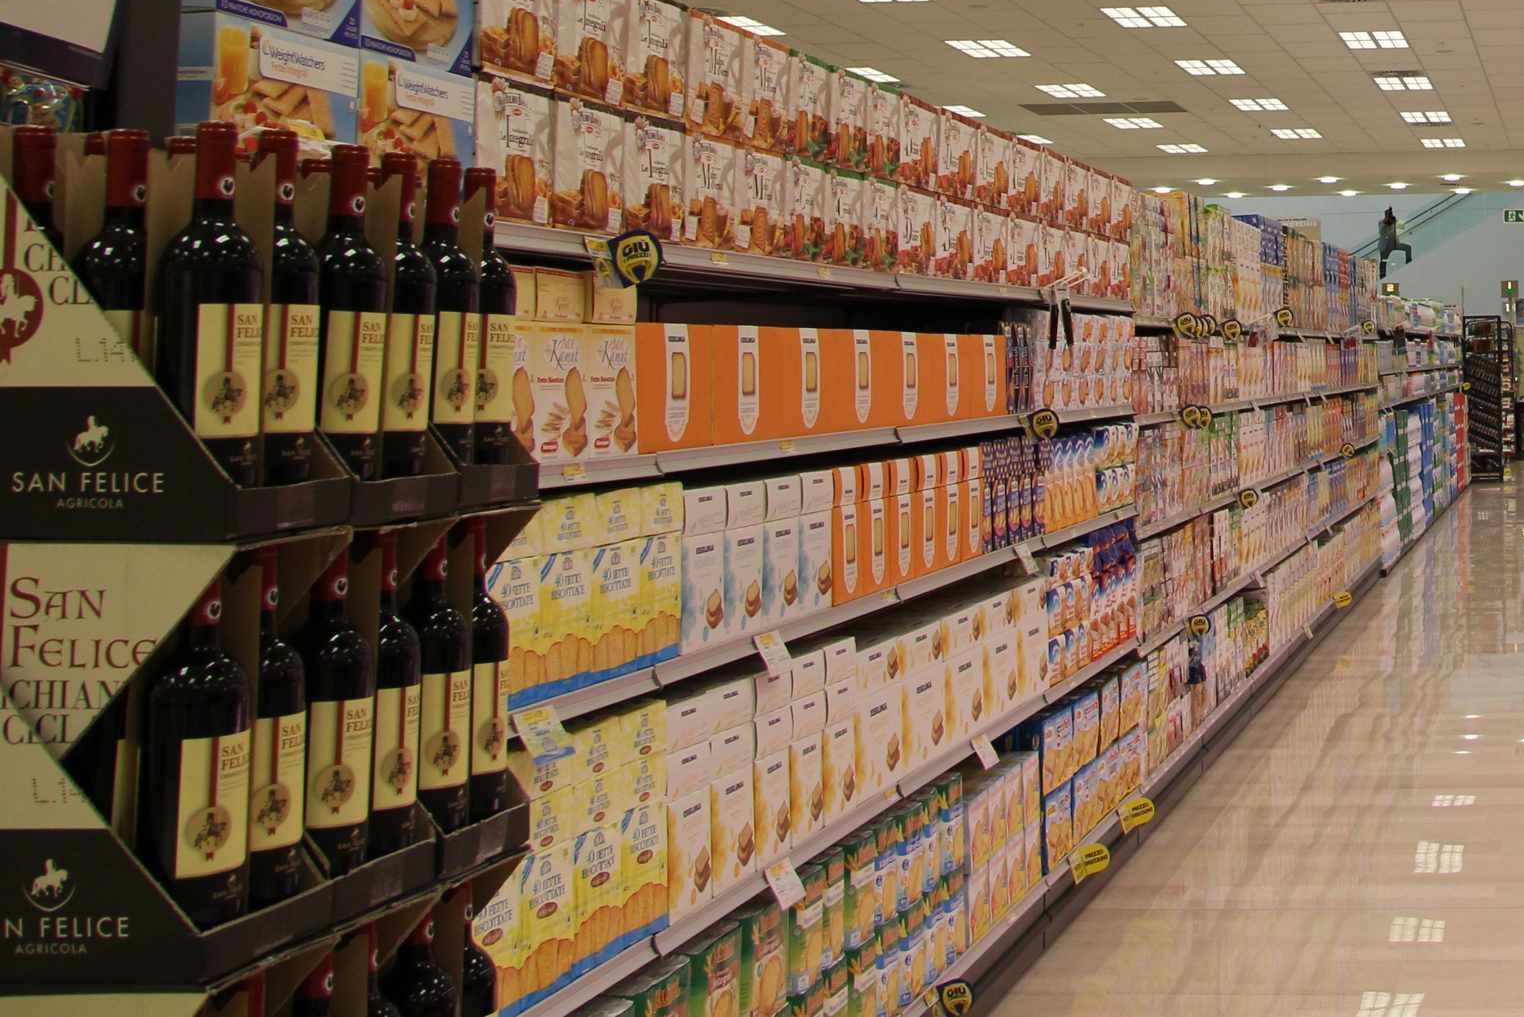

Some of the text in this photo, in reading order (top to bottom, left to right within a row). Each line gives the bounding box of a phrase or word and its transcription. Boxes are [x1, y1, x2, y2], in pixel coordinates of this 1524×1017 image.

[11, 471, 165, 493] SAN FELICE
[56, 497, 125, 509] AGRICOLA
[10, 576, 106, 620] SAN
[9, 623, 158, 669] FELICE
[40, 916, 130, 939] FELICE
[15, 943, 89, 955] AGRICOLA
